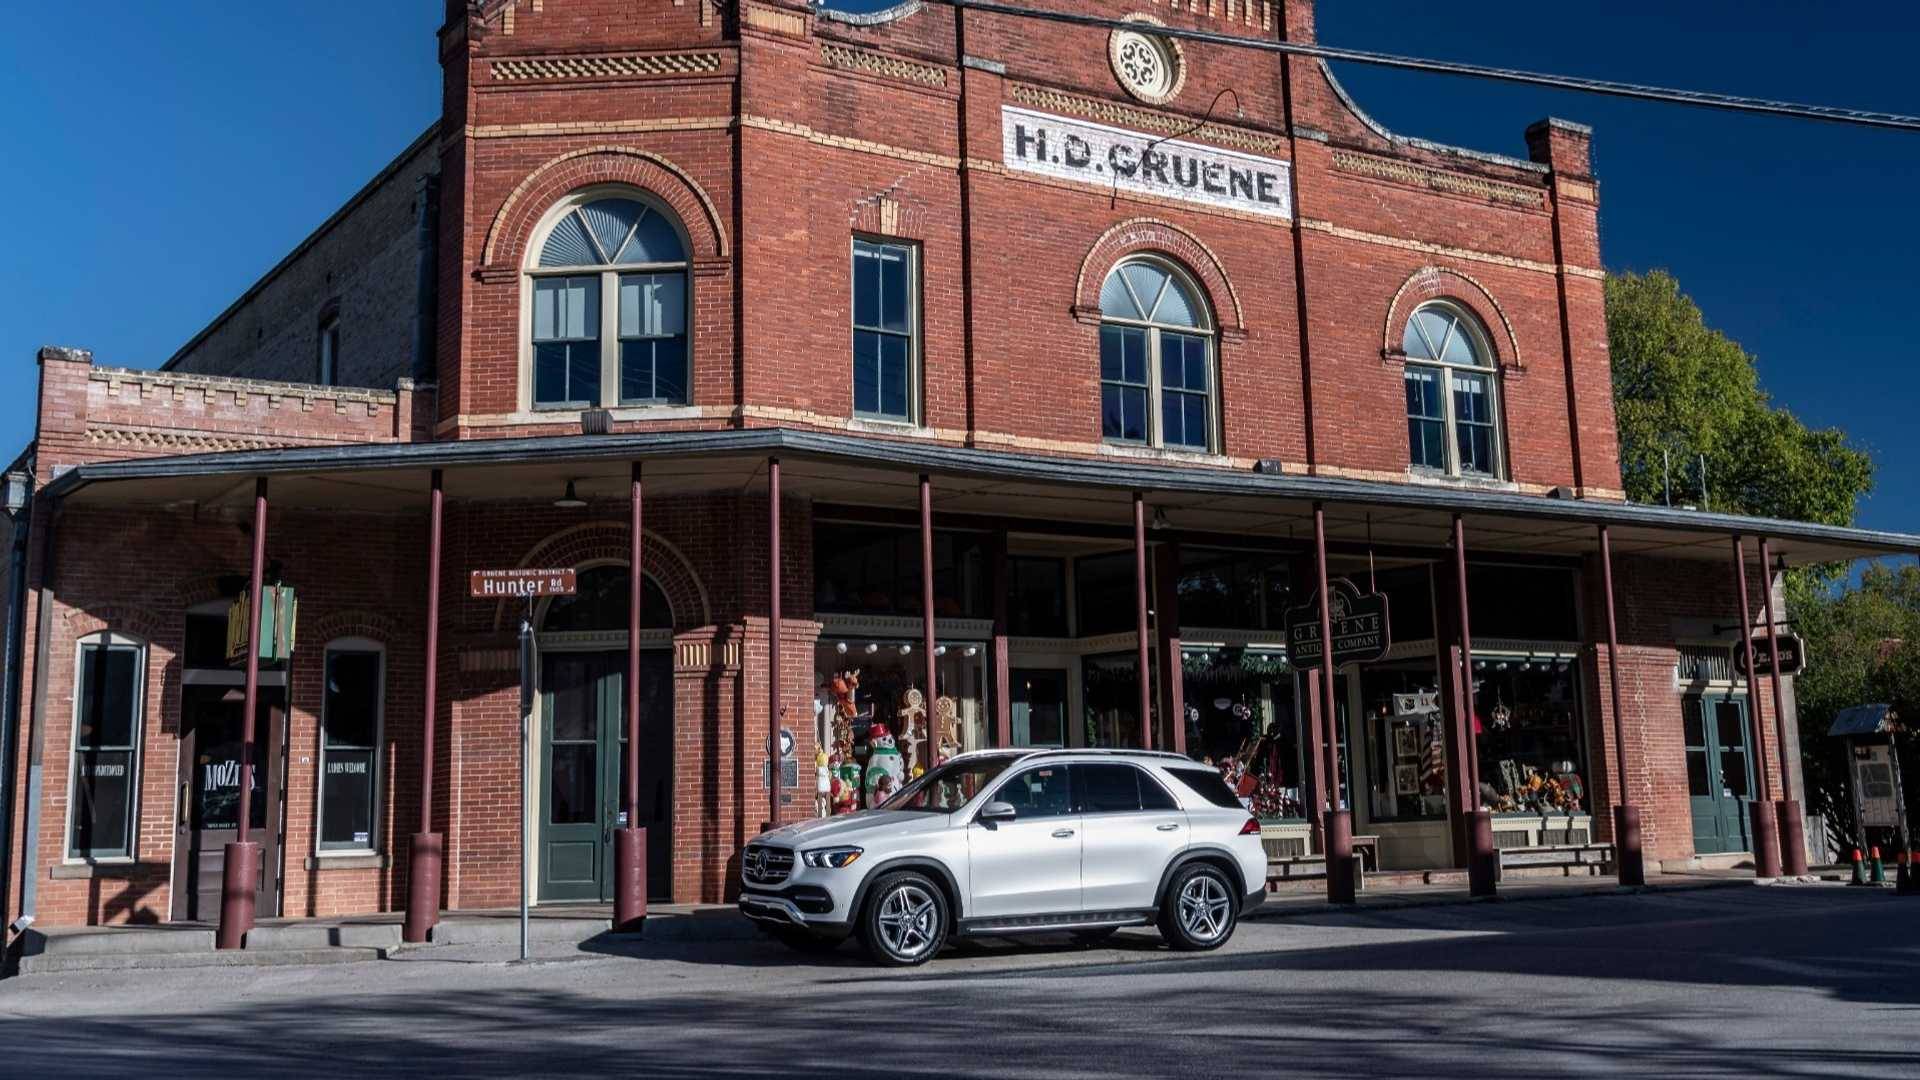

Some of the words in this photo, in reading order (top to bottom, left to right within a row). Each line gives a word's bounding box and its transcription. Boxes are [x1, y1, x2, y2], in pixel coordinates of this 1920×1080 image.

[1108, 143, 1280, 205] GRUENE
[483, 578, 544, 594] Hunter
[551, 577, 562, 586] Rd
[1293, 616, 1380, 640] GRENE
[1337, 636, 1380, 650] COMPANY
